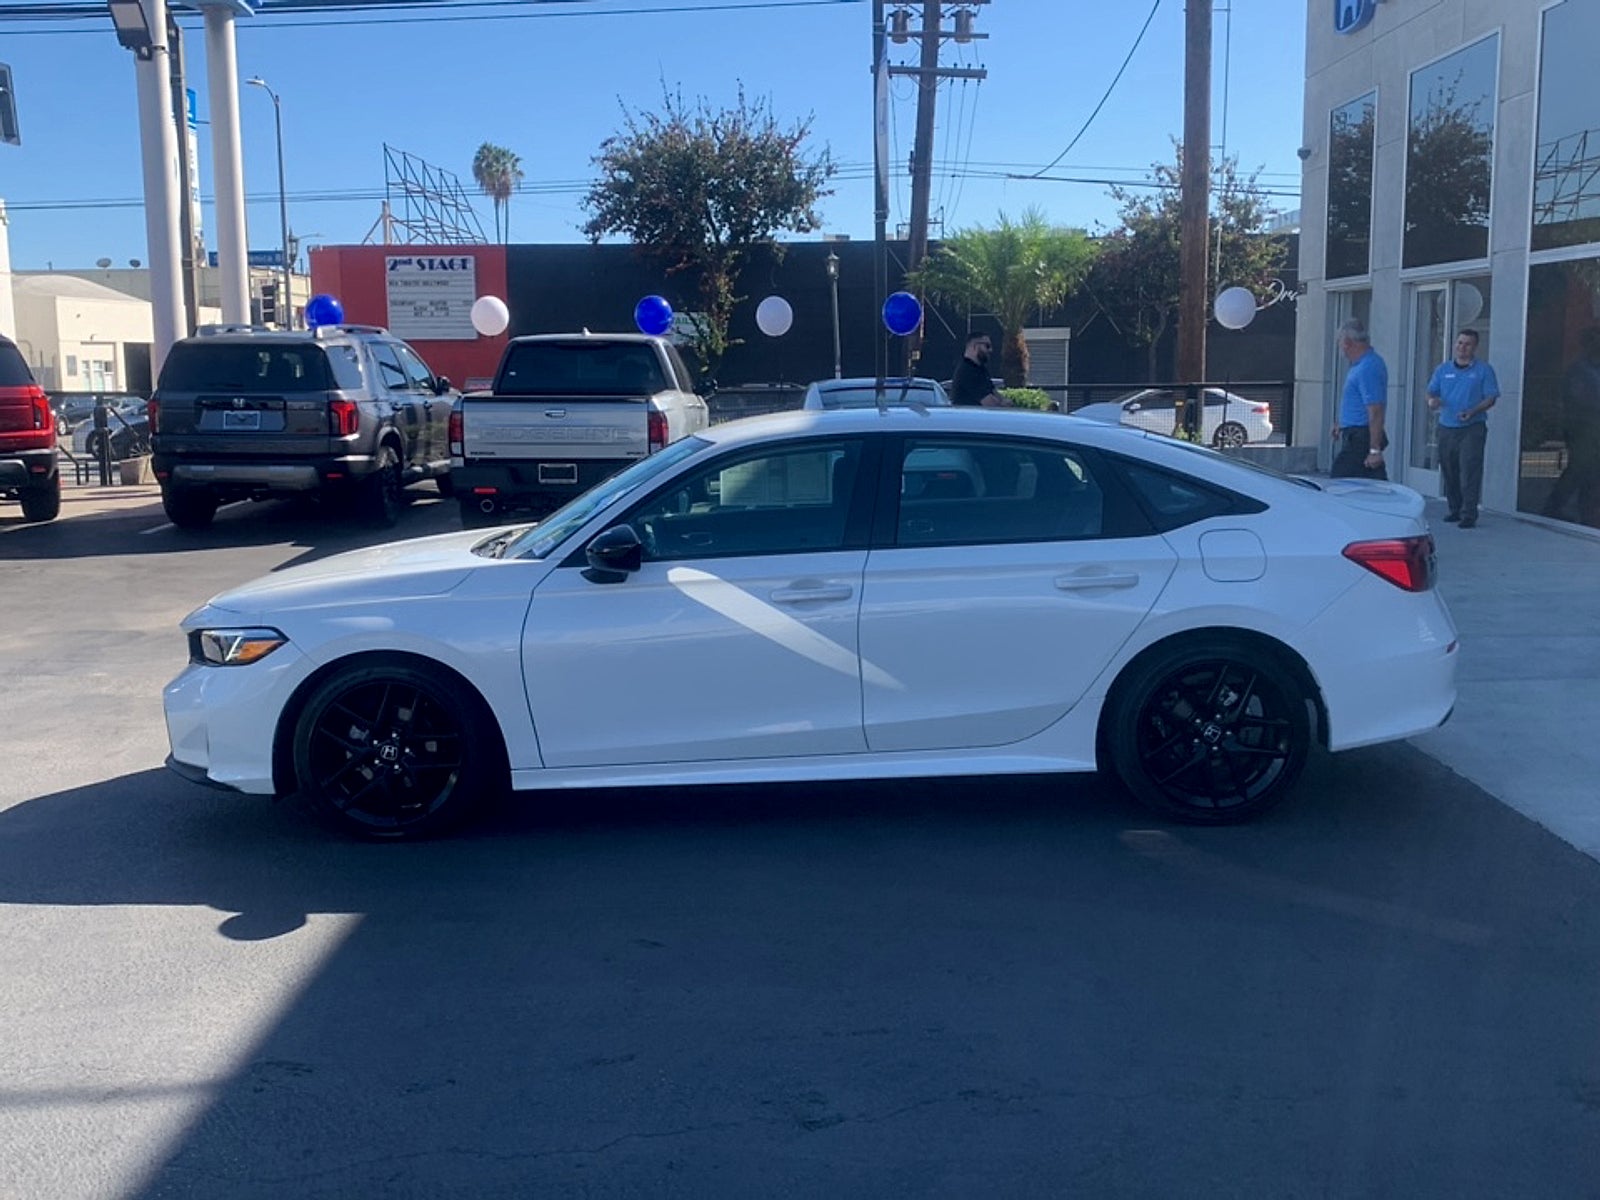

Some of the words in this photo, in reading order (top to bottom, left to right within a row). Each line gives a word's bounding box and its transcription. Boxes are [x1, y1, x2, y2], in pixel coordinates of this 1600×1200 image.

[388, 258, 412, 271] 2nd
[416, 258, 472, 271] STAGE
[480, 427, 633, 441] RIDGELINE
